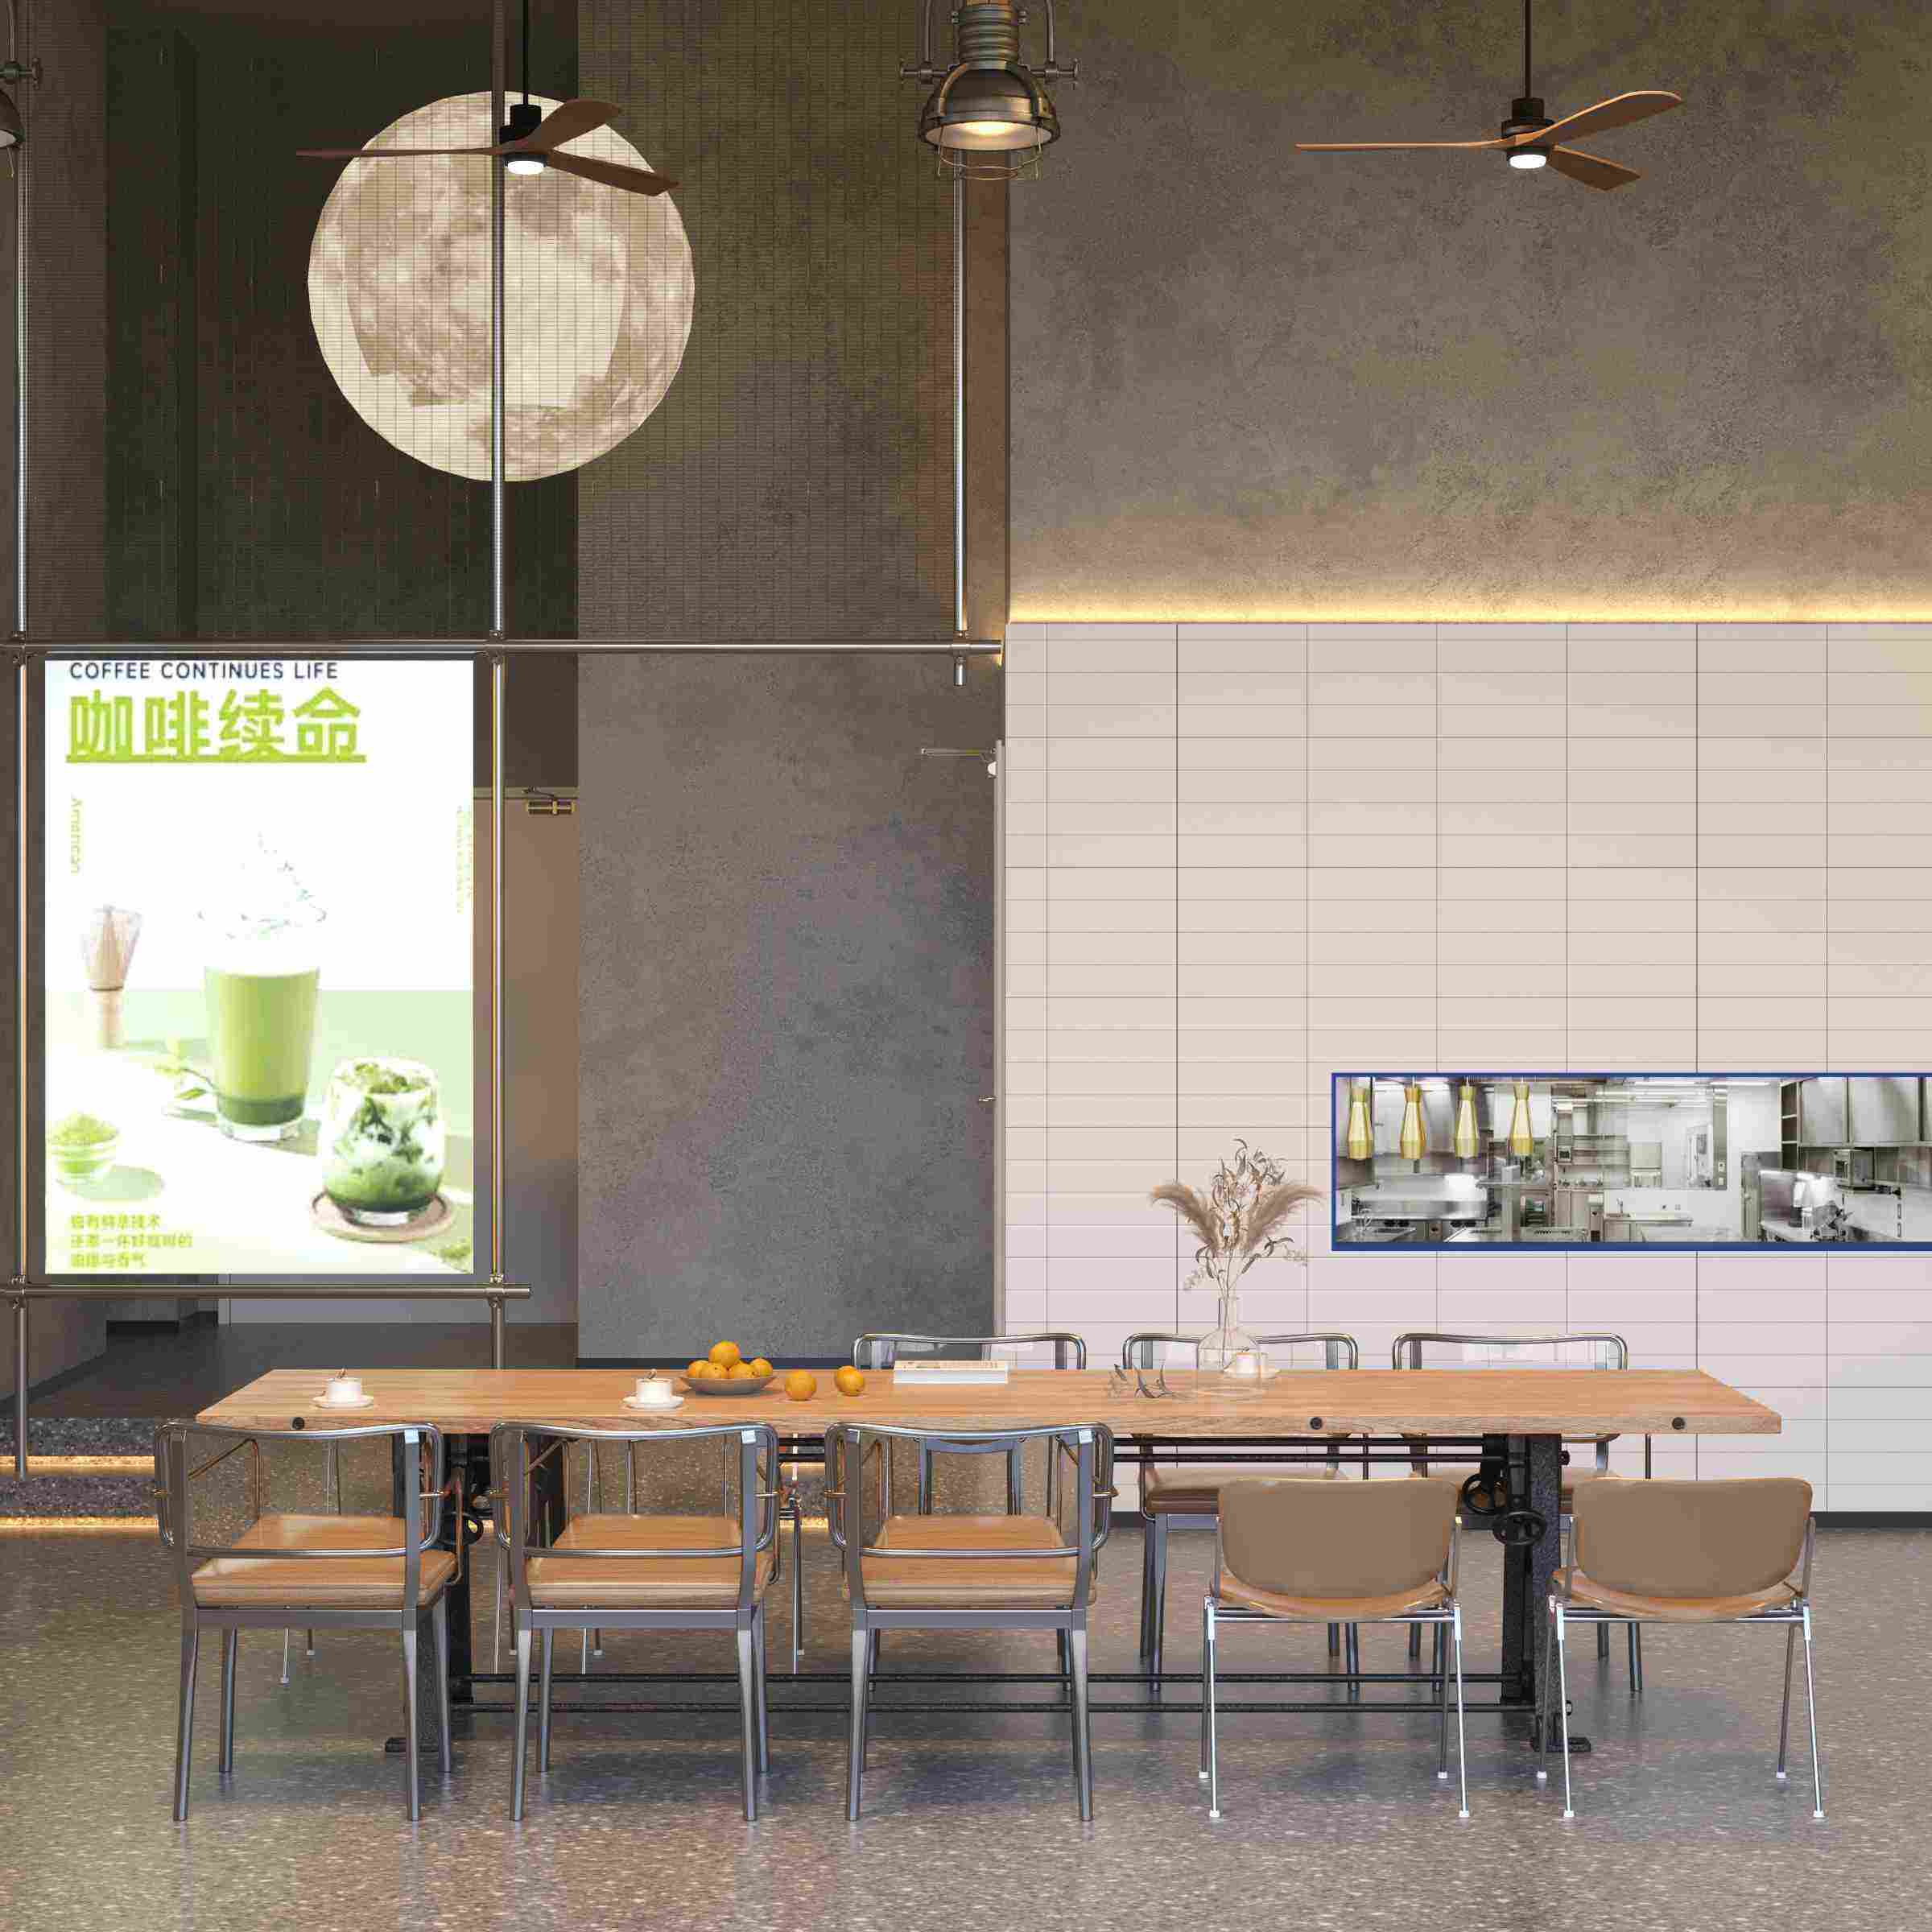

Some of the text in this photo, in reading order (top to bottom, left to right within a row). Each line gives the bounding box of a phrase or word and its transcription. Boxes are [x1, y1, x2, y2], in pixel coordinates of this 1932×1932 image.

[70, 662, 338, 679] COFFEE CONTINUES LIFE
[69, 687, 361, 759] 咖啡续命
